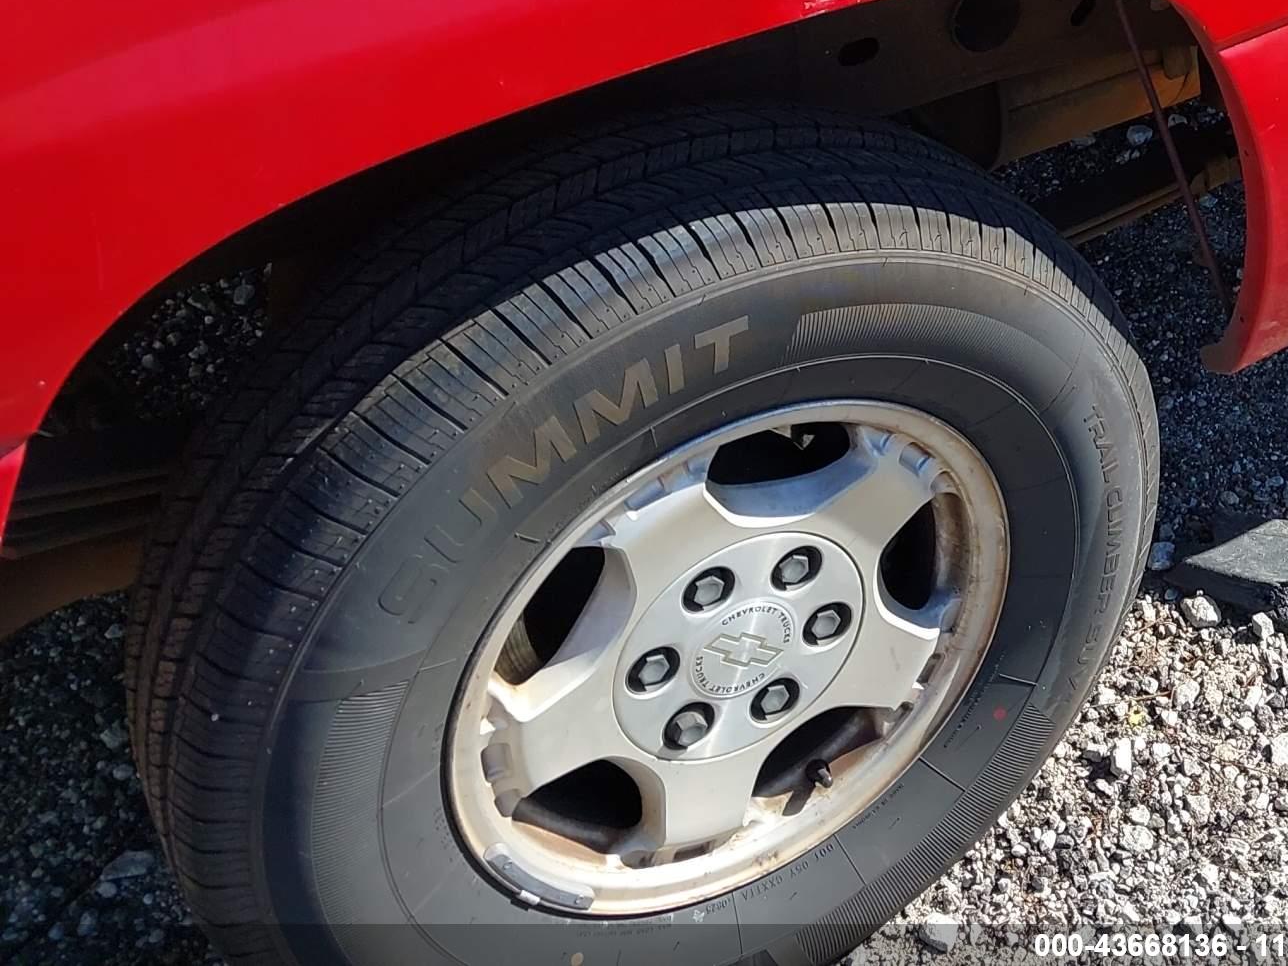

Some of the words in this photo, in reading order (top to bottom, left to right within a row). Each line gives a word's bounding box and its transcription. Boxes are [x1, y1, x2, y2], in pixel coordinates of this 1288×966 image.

[377, 315, 749, 624] SUMMIT
[721, 605, 778, 626] CHEVROLET
[777, 610, 790, 644] TRUCKS
[709, 671, 766, 694] CHEVROLET
